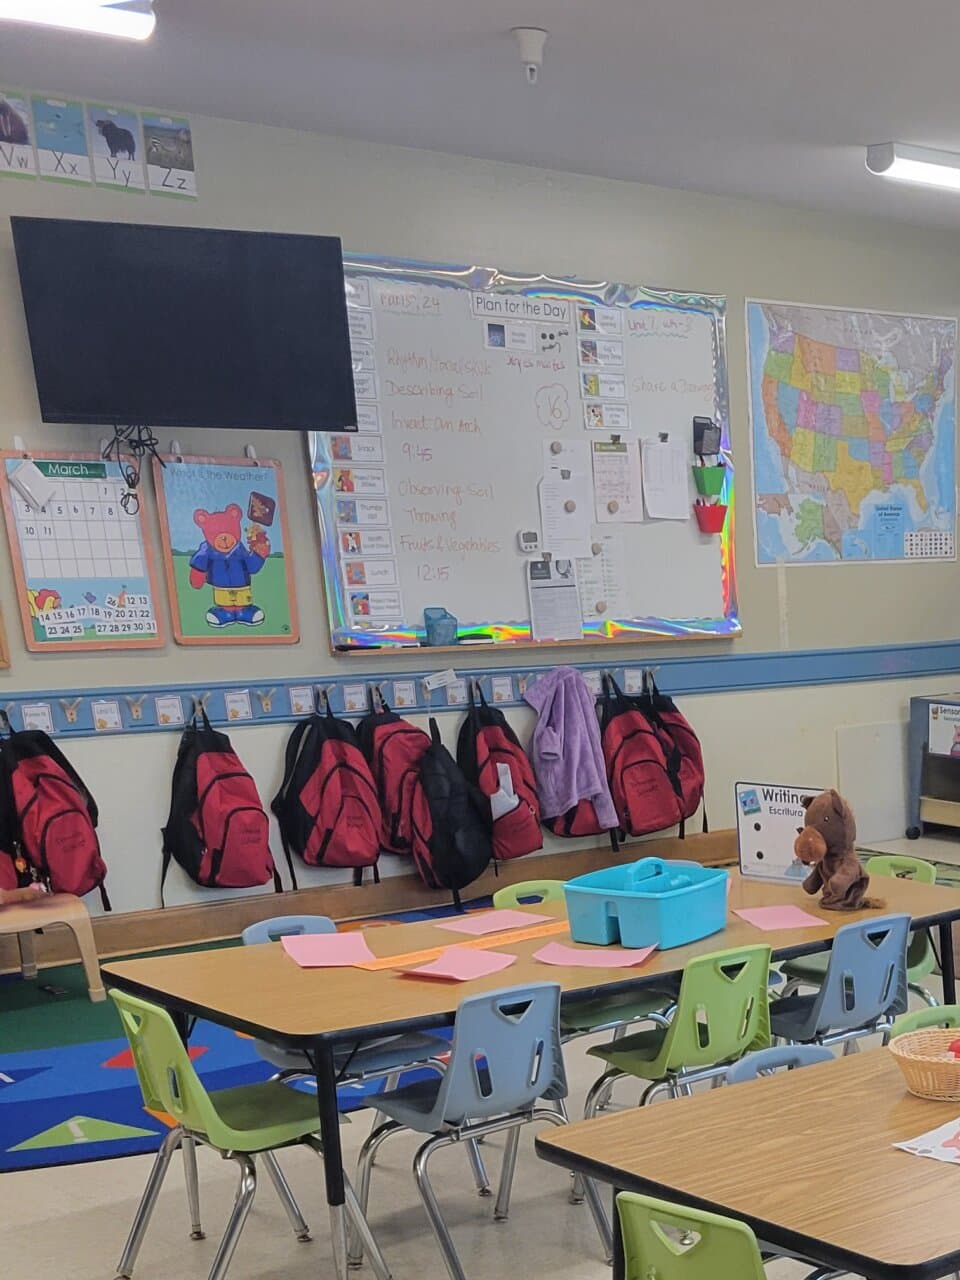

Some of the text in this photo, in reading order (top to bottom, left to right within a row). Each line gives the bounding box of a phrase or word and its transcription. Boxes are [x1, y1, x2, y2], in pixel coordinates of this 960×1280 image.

[52, 150, 79, 175] Xx
[107, 157, 131, 188] Yy
[161, 168, 188, 190] Zz
[476, 296, 567, 319] Plan for the Day
[402, 442, 433, 462] 9:45
[48, 463, 89, 475] March
[41, 506, 47, 515] 4
[57, 507, 63, 515] 5
[90, 507, 95, 515] 7
[107, 507, 114, 516] 8
[25, 526, 52, 536] 10 11
[416, 564, 450, 582] 12:15
[107, 596, 148, 607] 26 12 13
[41, 607, 150, 622] 14 15 16 17 18 19 20 21 22
[48, 622, 156, 635] 23 24 25 27 28 29 30 31
[768, 806, 804, 817] Escritura
